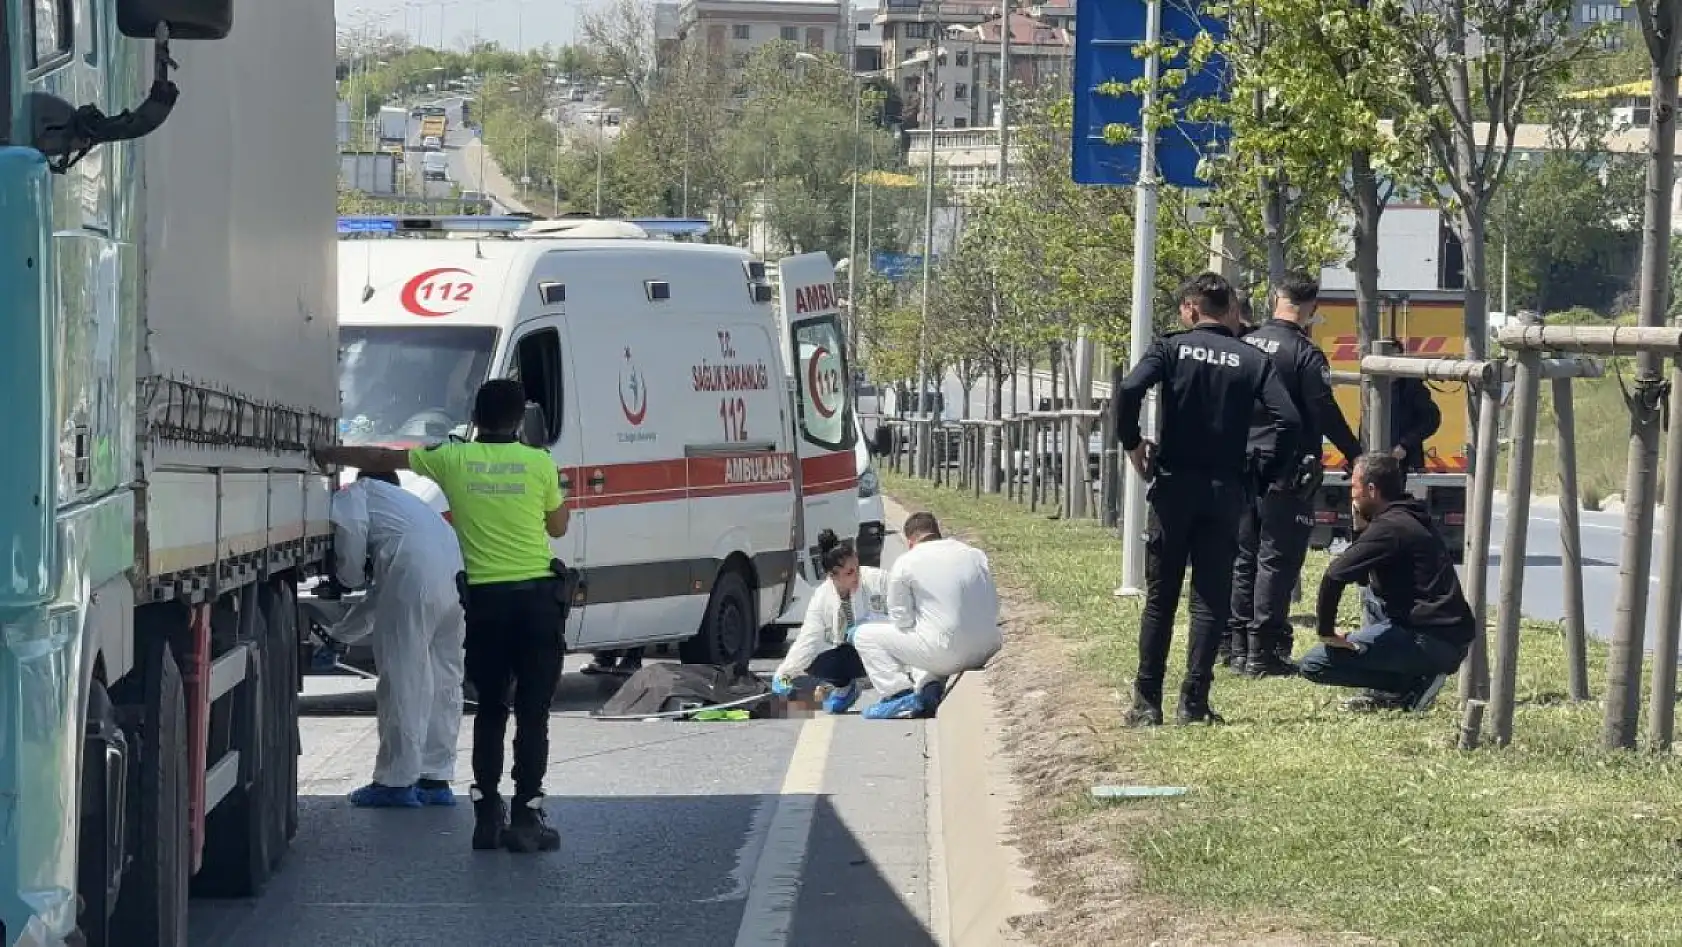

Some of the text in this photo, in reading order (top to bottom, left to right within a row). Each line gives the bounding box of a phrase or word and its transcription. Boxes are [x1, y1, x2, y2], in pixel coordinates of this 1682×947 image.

[421, 282, 473, 301] 112
[818, 368, 839, 395] 112
[720, 398, 748, 442] 112
